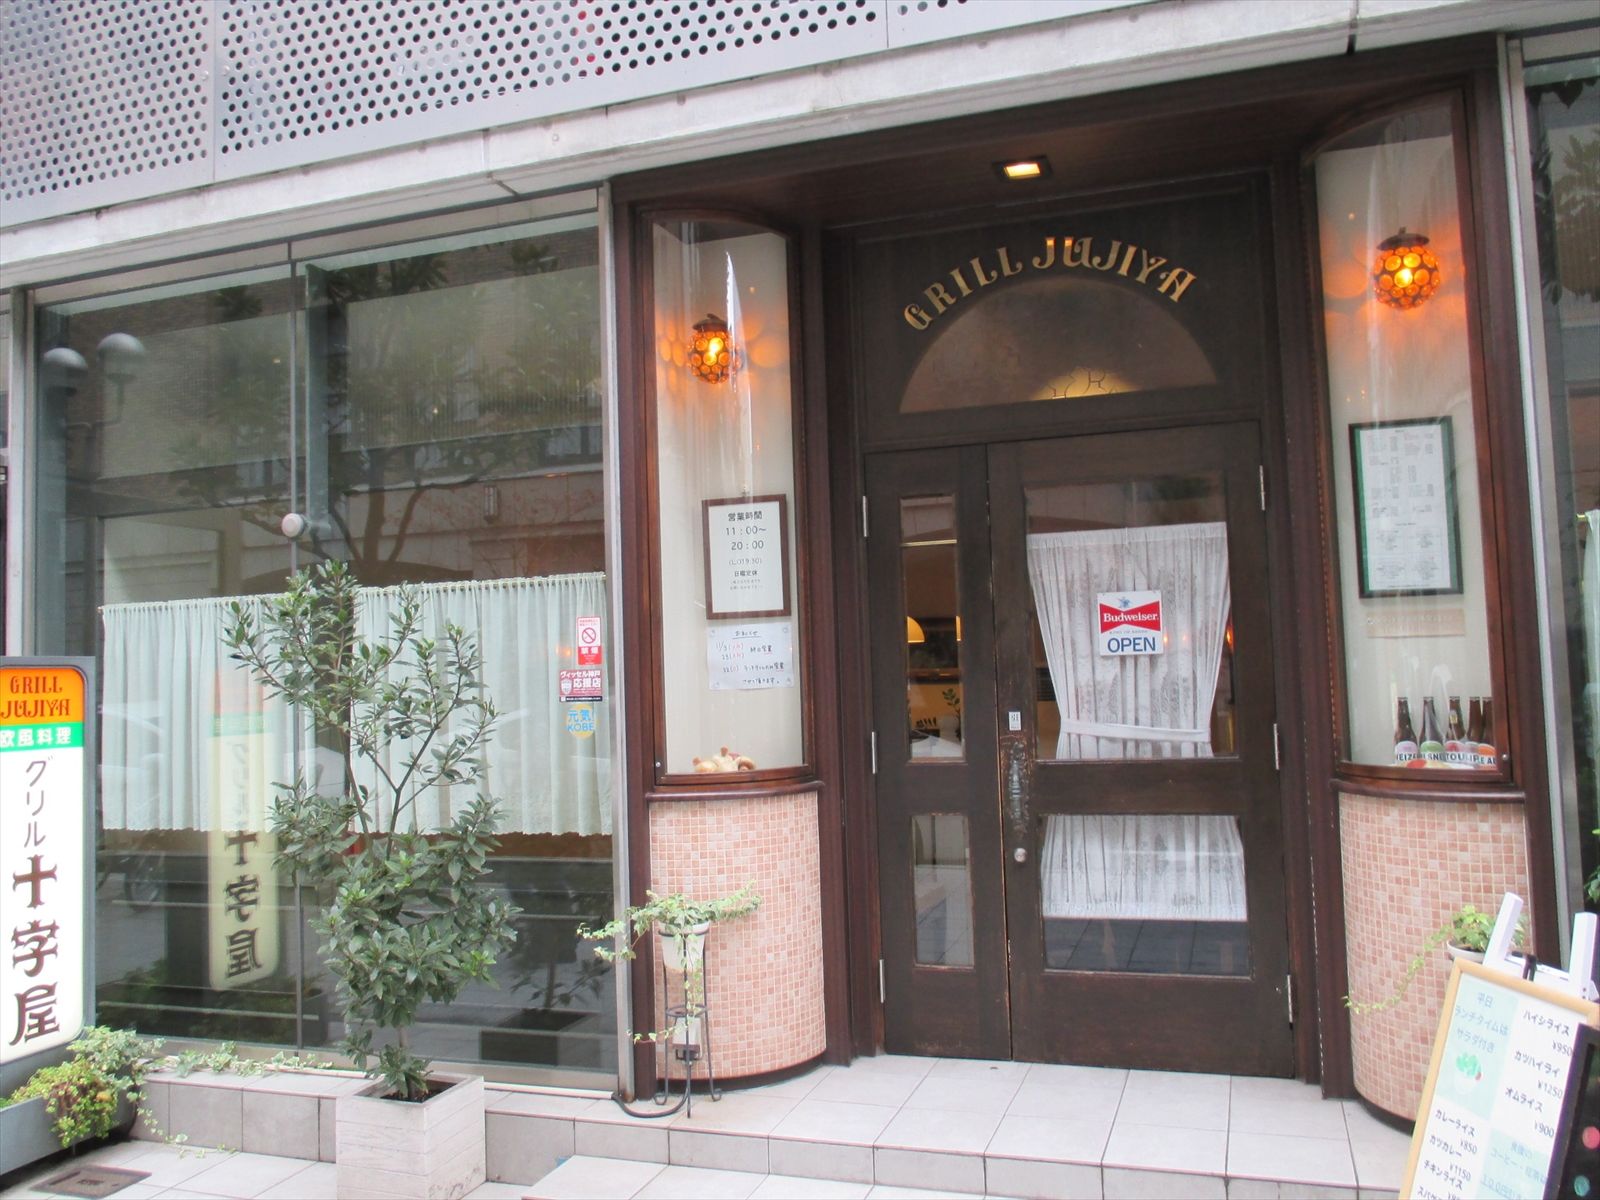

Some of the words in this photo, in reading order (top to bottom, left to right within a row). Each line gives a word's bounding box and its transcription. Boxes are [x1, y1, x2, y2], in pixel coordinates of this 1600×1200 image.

[904, 246, 1023, 331] GRILL
[1032, 236, 1197, 302] JUJIYA
[727, 511, 763, 521] 営業時間
[731, 540, 764, 550] 20:00
[1107, 637, 1156, 653] OPEN
[10, 675, 63, 694] GRILL
[0, 698, 71, 719] JUJIYA
[0, 727, 72, 748] 欧風料理
[1505, 1087, 1544, 1112] オムライス
[1435, 1109, 1475, 1136] カレーライス
[1429, 1135, 1462, 1157] カツカレー
[1423, 1159, 1463, 1190] チキンライス
